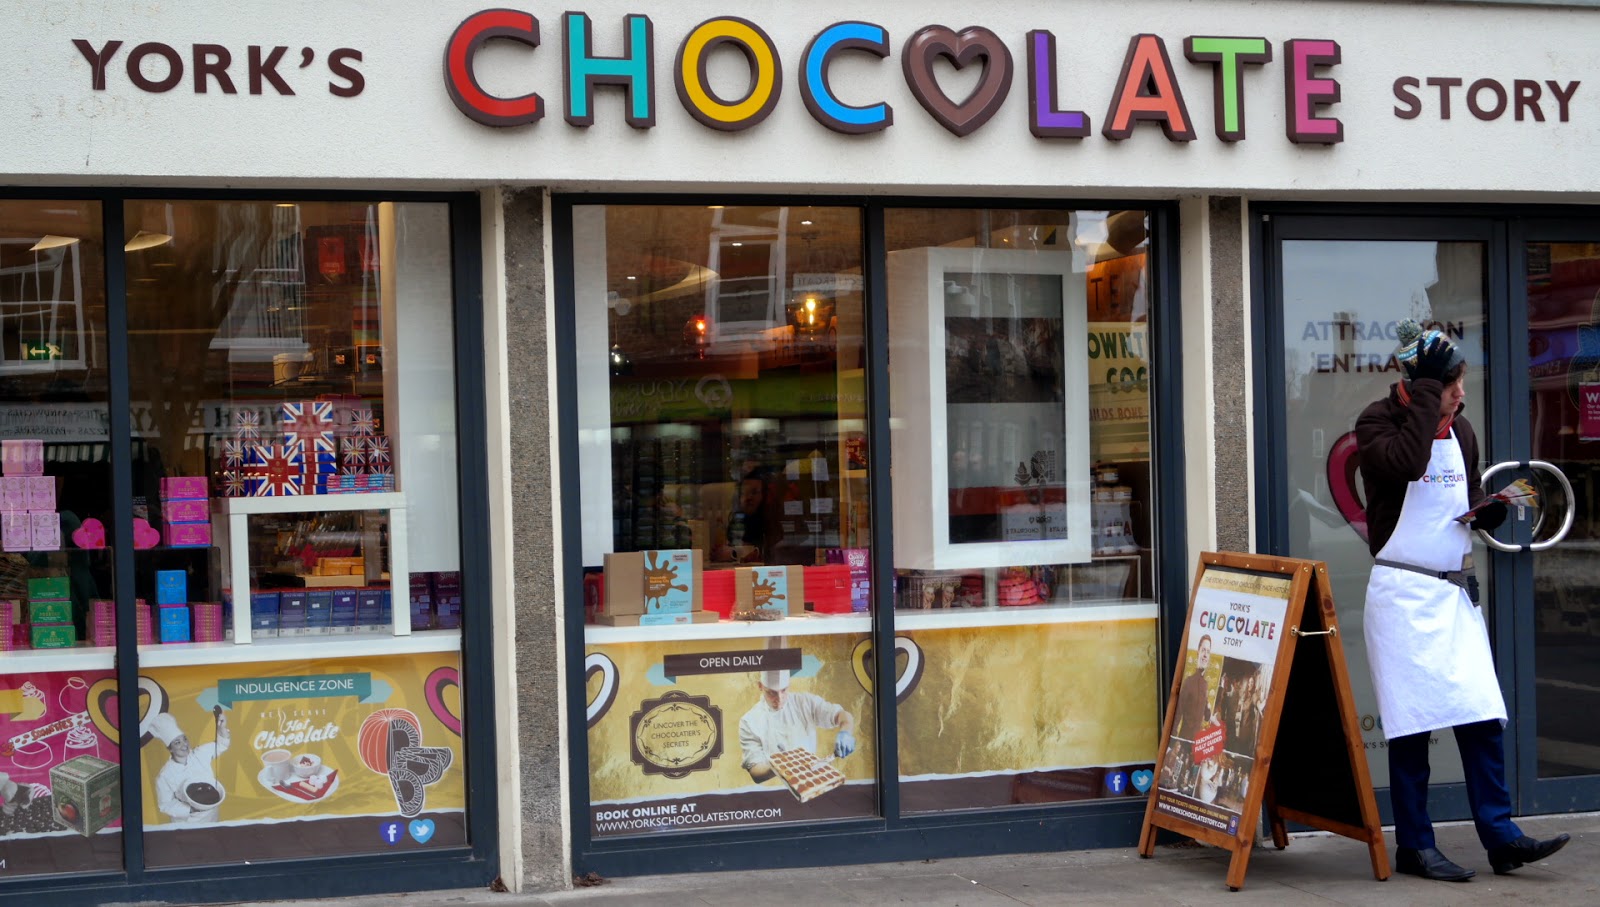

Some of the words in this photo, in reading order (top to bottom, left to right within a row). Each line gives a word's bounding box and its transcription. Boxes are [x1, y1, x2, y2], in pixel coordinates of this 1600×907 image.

[72, 39, 366, 98] YORK'S
[443, 8, 1344, 145] CHOCOLATE
[1392, 76, 1581, 122] STORY
[1302, 321, 1464, 340] ATTRACN
[1317, 353, 1400, 374] ENTRA
[1200, 611, 1276, 640] CHOCOLATE
[1223, 636, 1243, 648] STORY
[699, 656, 730, 669] OPEN
[732, 655, 764, 668] DAILY
[235, 681, 316, 695] INDULGENCE
[318, 678, 354, 691] ZONE
[282, 718, 310, 733] Hot
[652, 721, 684, 730] UNCOVER
[685, 719, 698, 728] THE
[254, 722, 340, 750] Chocolate
[663, 740, 690, 749] SECRETS
[1195, 729, 1222, 745] FASCINATING
[1202, 746, 1214, 755] TOUR
[595, 808, 782, 832] WWW.YORKSCHOCOLATESTORY.COM
[596, 808, 629, 821] BOOK
[633, 805, 677, 818] ONLINE
[680, 803, 697, 814] AT
